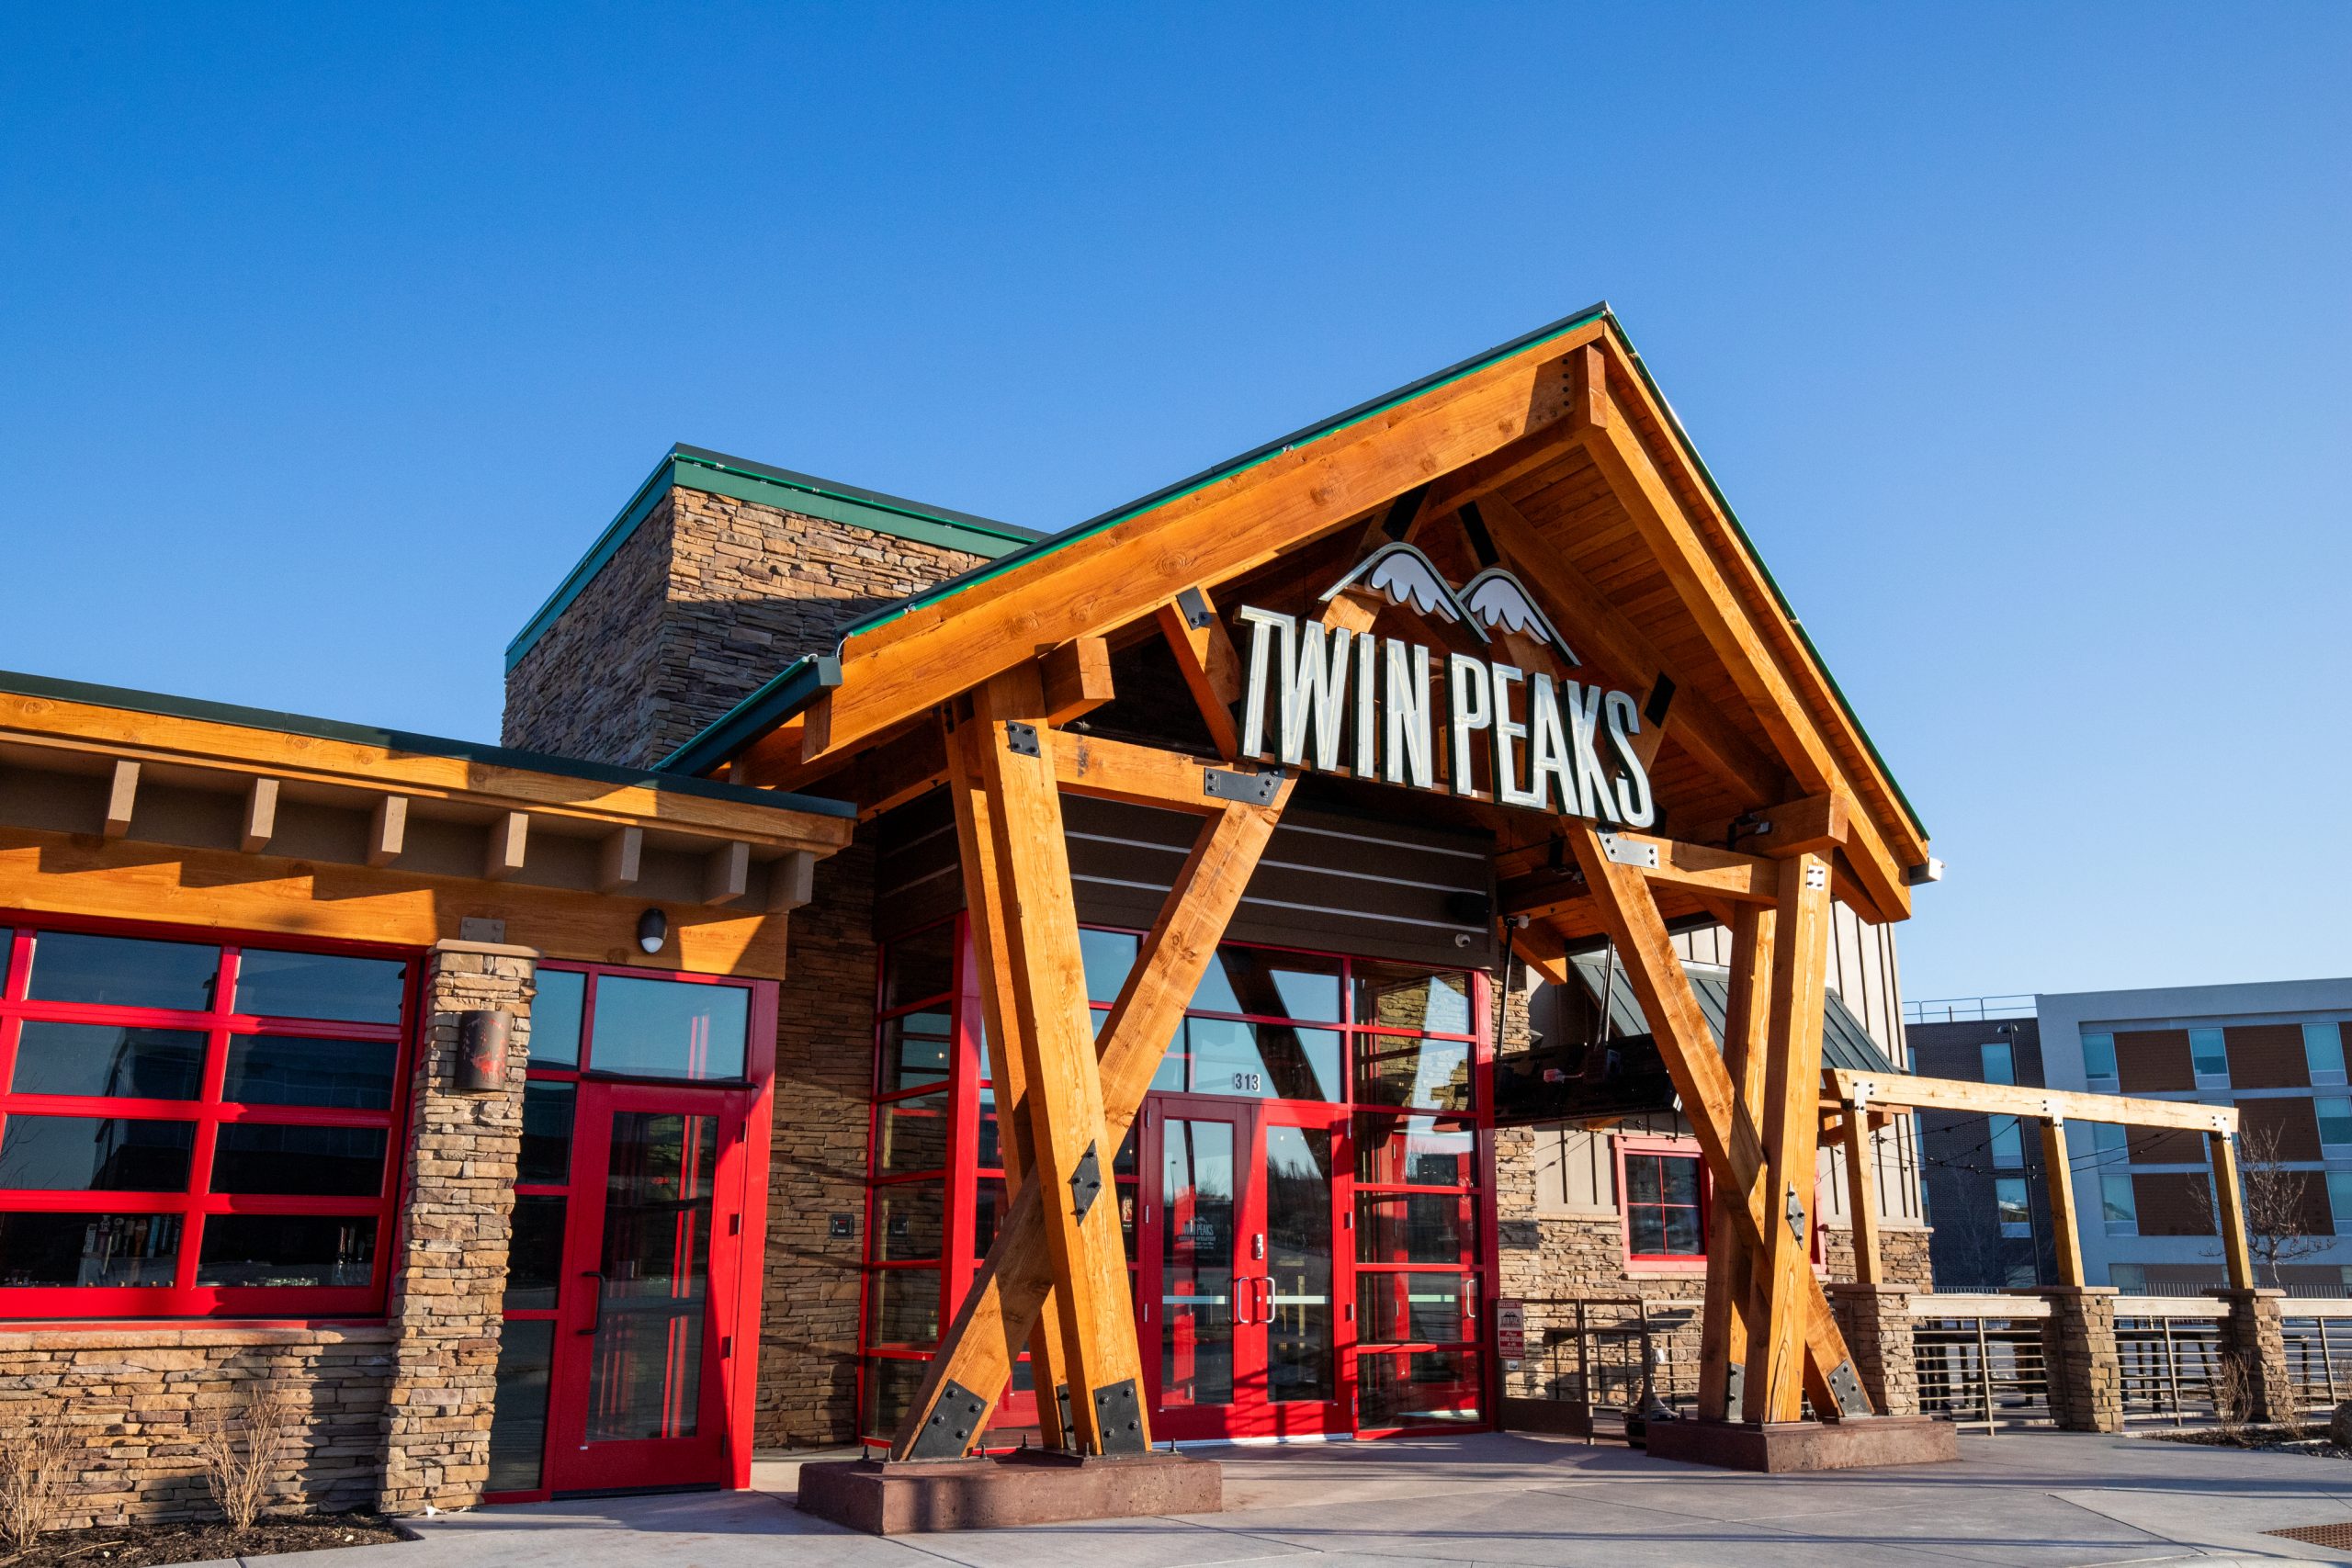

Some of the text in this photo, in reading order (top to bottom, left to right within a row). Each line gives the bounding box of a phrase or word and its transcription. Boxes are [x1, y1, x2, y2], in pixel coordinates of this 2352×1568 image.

[1235, 604, 1655, 829] TWIN PEAKS
[1235, 1073, 1259, 1090] 313
[1196, 1224, 1214, 1235] PEAKS
